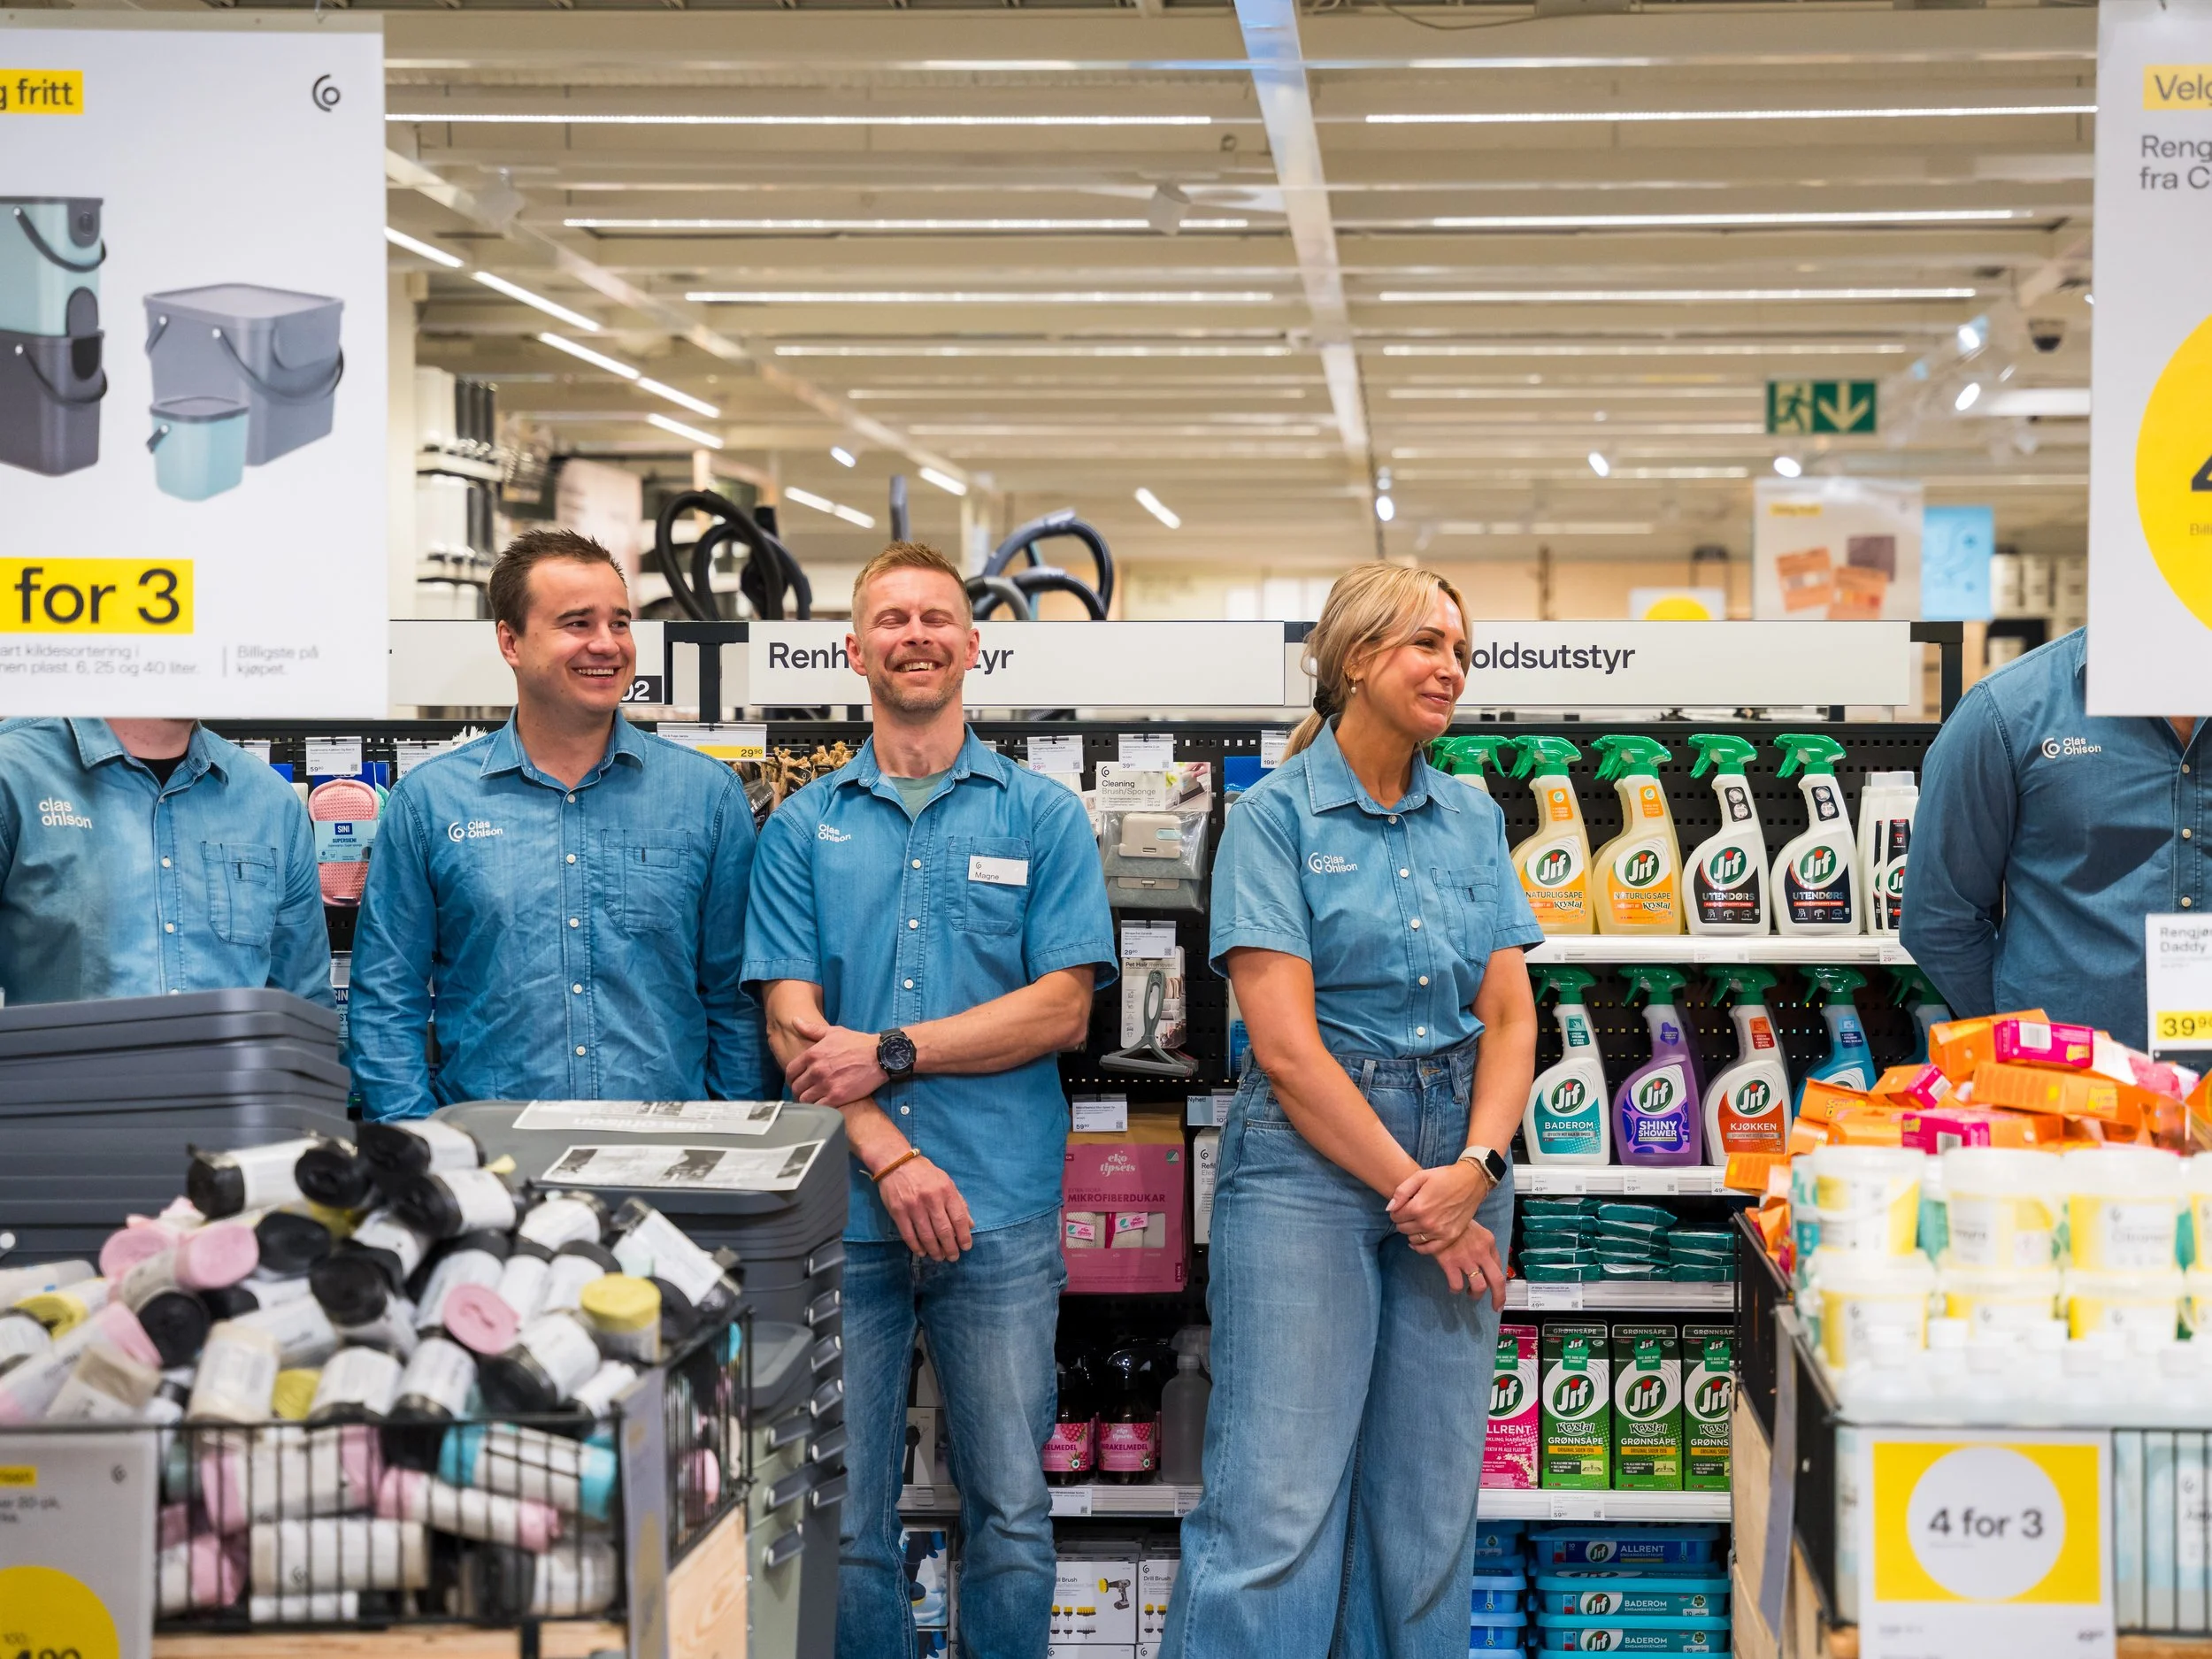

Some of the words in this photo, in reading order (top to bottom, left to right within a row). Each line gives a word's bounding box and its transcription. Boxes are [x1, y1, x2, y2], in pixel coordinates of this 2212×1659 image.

[17, 78, 73, 105] fritt
[2139, 166, 2178, 189] fra
[14, 567, 117, 624] for
[137, 568, 180, 626] 3
[26, 643, 132, 660] kildesortering
[236, 645, 295, 660] Billigste
[299, 644, 319, 659] på
[1471, 642, 1635, 674] oldsutstyr
[94, 661, 114, 673] 25
[119, 664, 139, 677] og
[142, 661, 165, 673] 40
[2062, 737, 2086, 746] Clas
[2063, 744, 2101, 756] Ohlson
[1102, 780, 1135, 788] Cleaning
[39, 797, 73, 812] clas
[41, 810, 92, 829] ohlson
[467, 820, 490, 830] Clas
[467, 827, 503, 838] Ohlson
[818, 823, 840, 835] Clas
[818, 832, 851, 842] Ohlson
[1323, 855, 1344, 864] Clas
[1540, 852, 1567, 881] Jif
[1713, 850, 1742, 879] Jif
[1803, 849, 1832, 879] Jif
[1325, 863, 1358, 872] Ohlson
[1628, 853, 1655, 882] Jif
[1890, 868, 1905, 891] Ji
[1702, 892, 1755, 901] UTENDØRS
[1554, 900, 1583, 910] Krystal
[1642, 901, 1671, 911] Krystal
[2160, 941, 2208, 955] Daddy
[1555, 1082, 1581, 1109] Jif
[1643, 1080, 1669, 1109] Jif
[1740, 1082, 1765, 1110] Jif
[1544, 1121, 1594, 1130] BADEROM
[1639, 1120, 1677, 1130] SHINY
[1730, 1122, 1777, 1132] KJØKKEN
[1067, 1194, 1165, 1202] MIKROFIBERDUKAR
[1498, 1339, 1513, 1349] Jif
[1568, 1339, 1584, 1349] Jif
[1640, 1340, 1655, 1349] Jif
[1709, 1340, 1724, 1350] Jif
[1489, 1378, 1517, 1411] Jif
[1556, 1378, 1589, 1411] Jif
[1629, 1379, 1661, 1413] Jif
[1699, 1379, 1731, 1413] Jif
[1556, 1422, 1595, 1435] Krystal
[1630, 1422, 1668, 1436] Krystal
[1548, 1436, 1603, 1445] GRØNNSÅPE
[1621, 1437, 1677, 1446] GRØNNSÅPE
[1929, 1509, 1950, 1536] 4
[1962, 1508, 2009, 1537] for
[2022, 1509, 2045, 1539] 3
[1592, 1544, 1606, 1559] Jif
[1588, 1595, 1608, 1615] Jif
[1589, 1632, 1608, 1651] Jif
